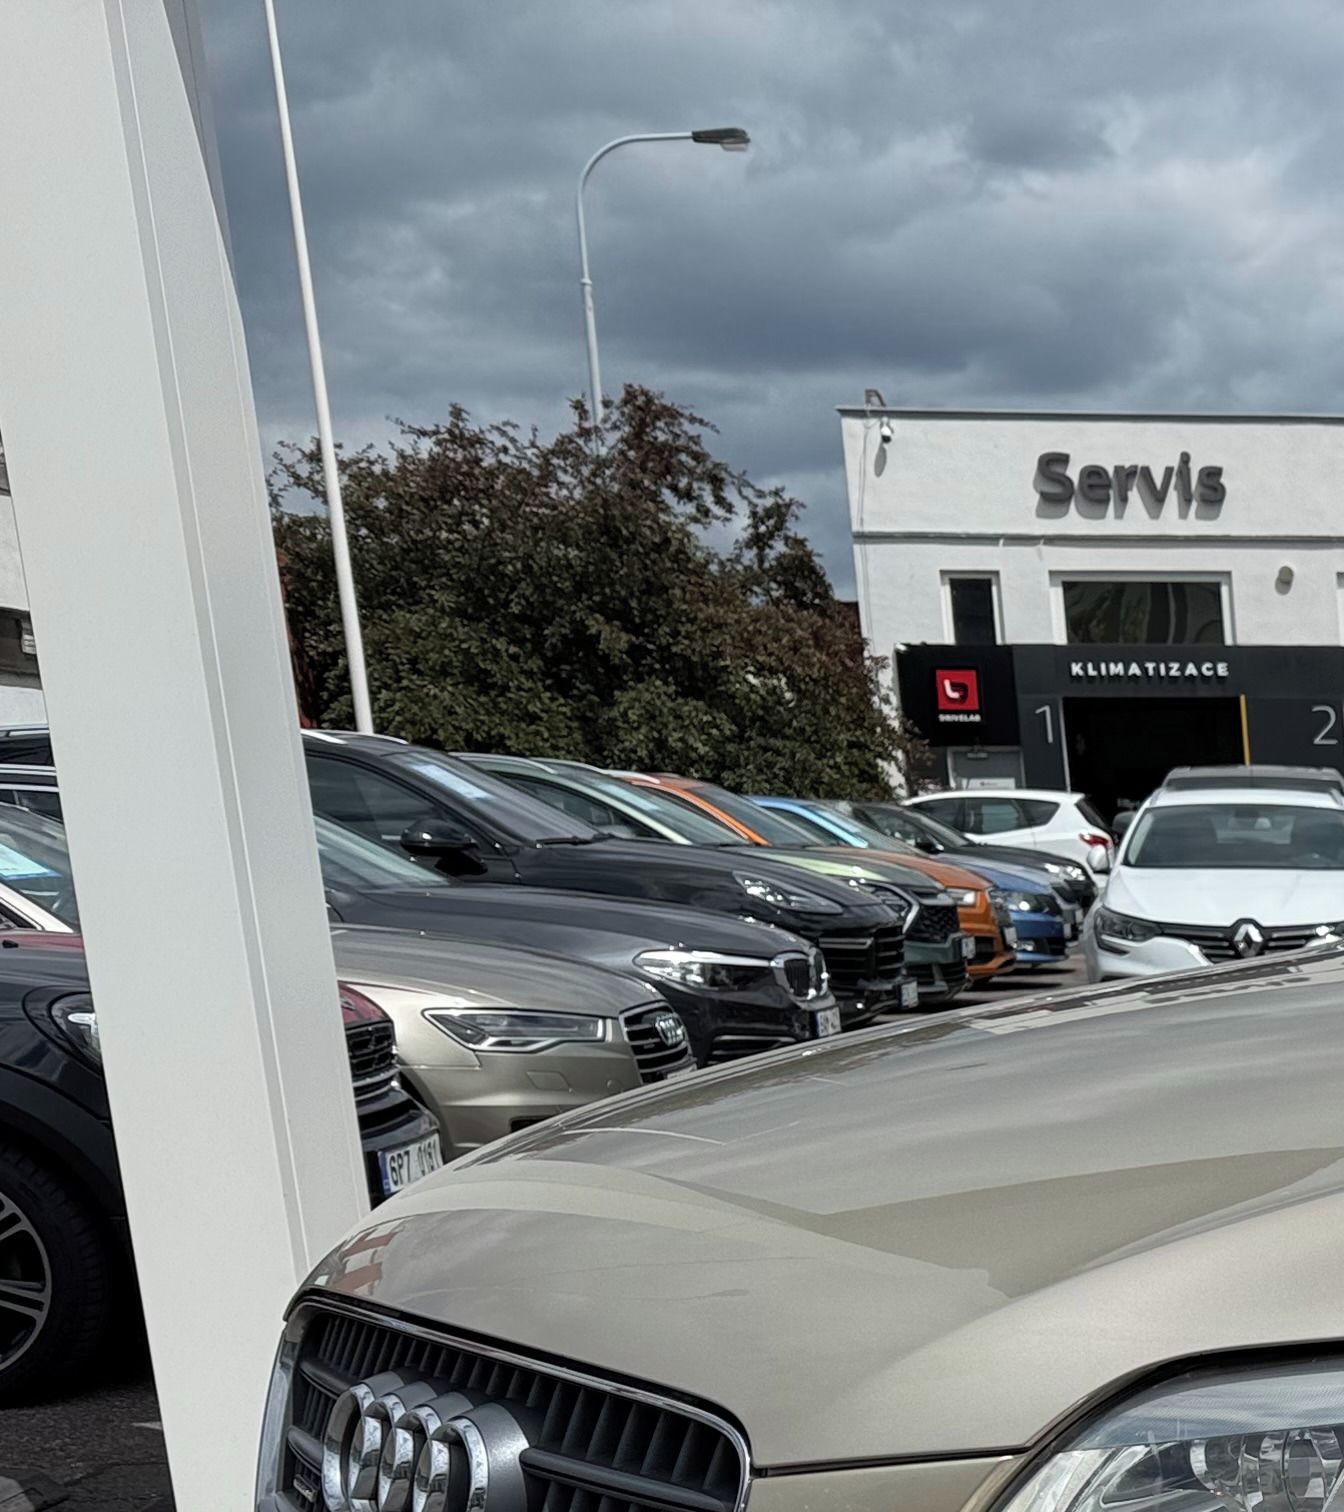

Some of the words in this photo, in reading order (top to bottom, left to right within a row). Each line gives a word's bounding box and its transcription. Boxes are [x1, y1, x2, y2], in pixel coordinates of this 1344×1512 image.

[1037, 451, 1227, 504] Servis
[1070, 661, 1230, 677] KLIMATIZACE
[1034, 704, 1055, 744] 1
[1310, 705, 1338, 746] 2
[389, 1150, 411, 1187] 6P7
